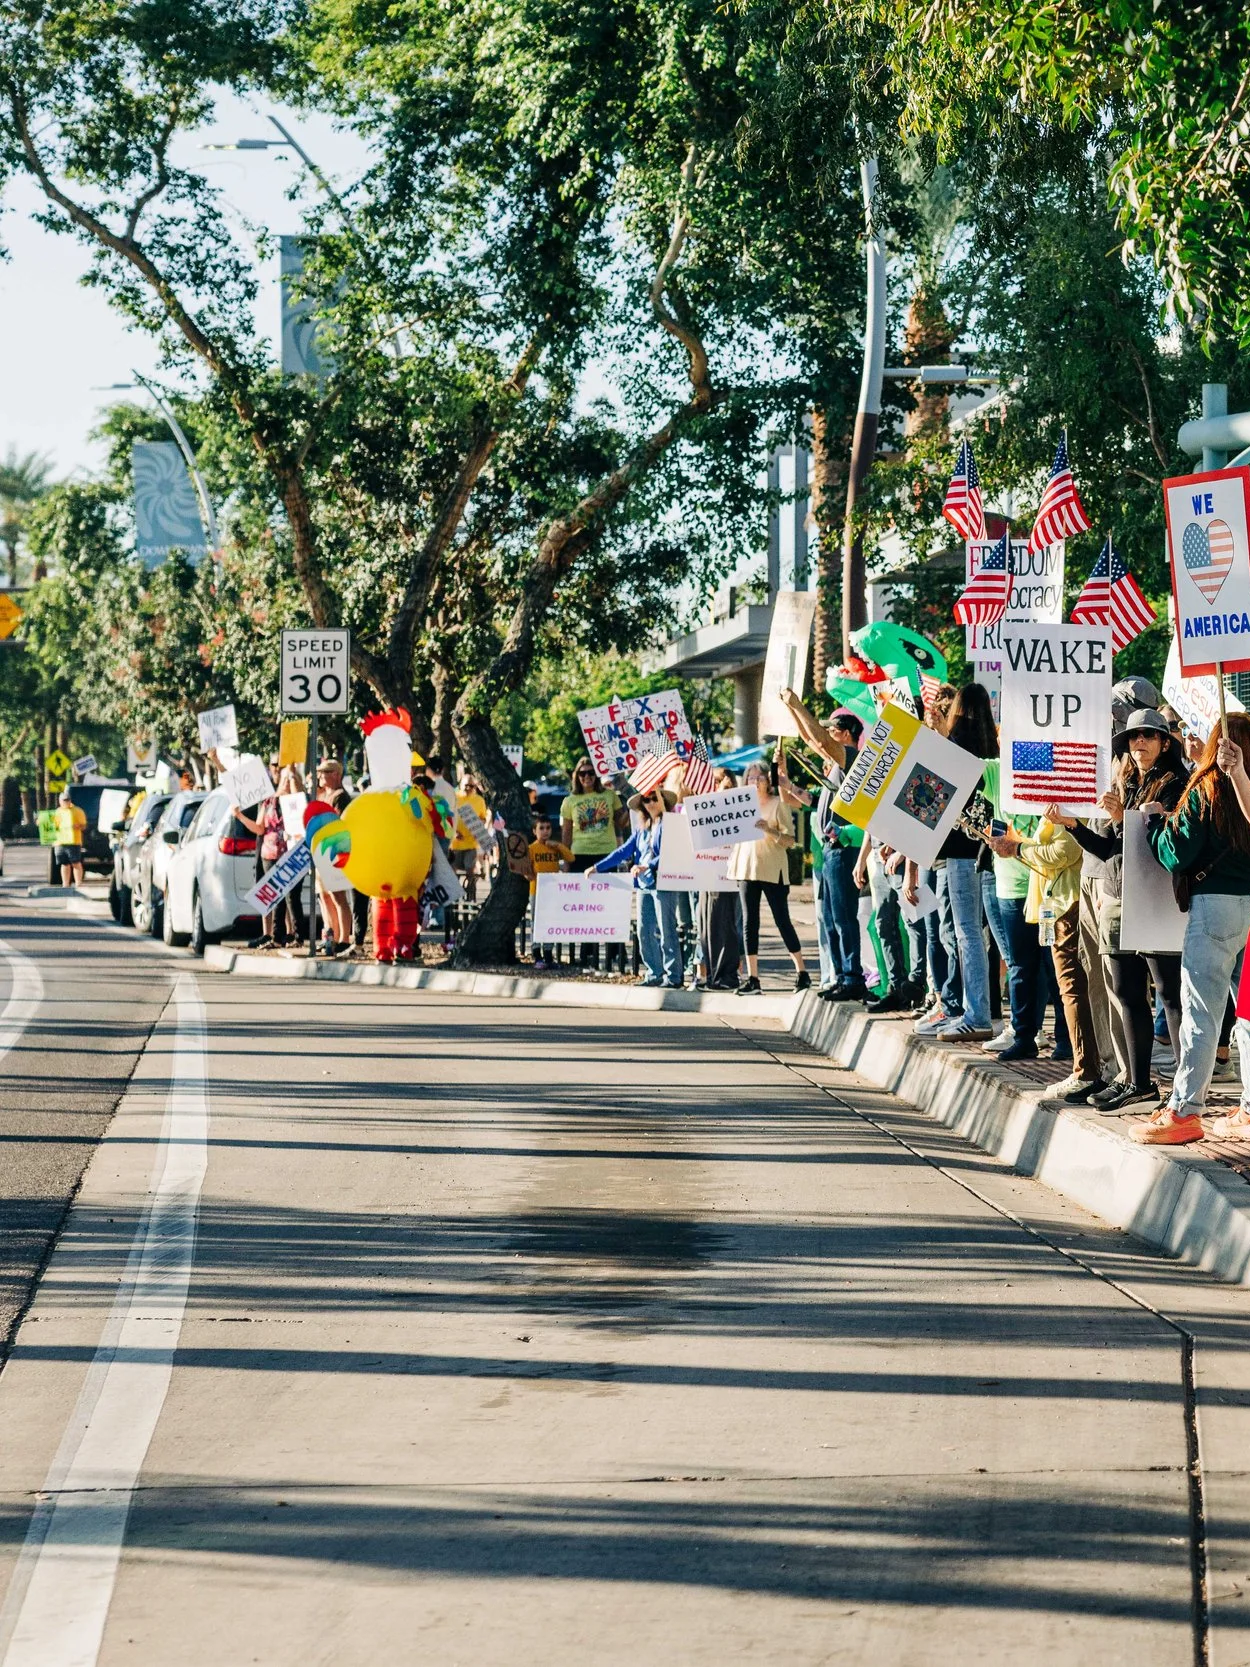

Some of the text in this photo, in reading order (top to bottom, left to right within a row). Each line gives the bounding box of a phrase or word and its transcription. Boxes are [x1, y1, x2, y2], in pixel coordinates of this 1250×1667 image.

[1191, 493, 1215, 516] WE
[287, 640, 343, 652] SPEED
[1003, 637, 1106, 675] WAKE
[293, 656, 337, 669] LIMIT
[288, 674, 342, 704] 30
[608, 697, 653, 722] FIX
[1030, 694, 1082, 728] UP
[584, 709, 686, 747] IMMIGRATION
[594, 737, 639, 760] STOP
[840, 720, 892, 803] COMMUNITY NOT
[864, 741, 901, 798] MONARCHY
[231, 771, 251, 788] No
[694, 793, 751, 811] FOX LIES
[690, 809, 757, 828] DEMOCRACY
[711, 825, 740, 838] DIES
[274, 845, 311, 888] KINGS
[695, 853, 729, 862] Arlington
[559, 883, 610, 892] TIME FOR
[563, 903, 604, 912] CARING
[547, 927, 616, 936] GOVERNANCE
